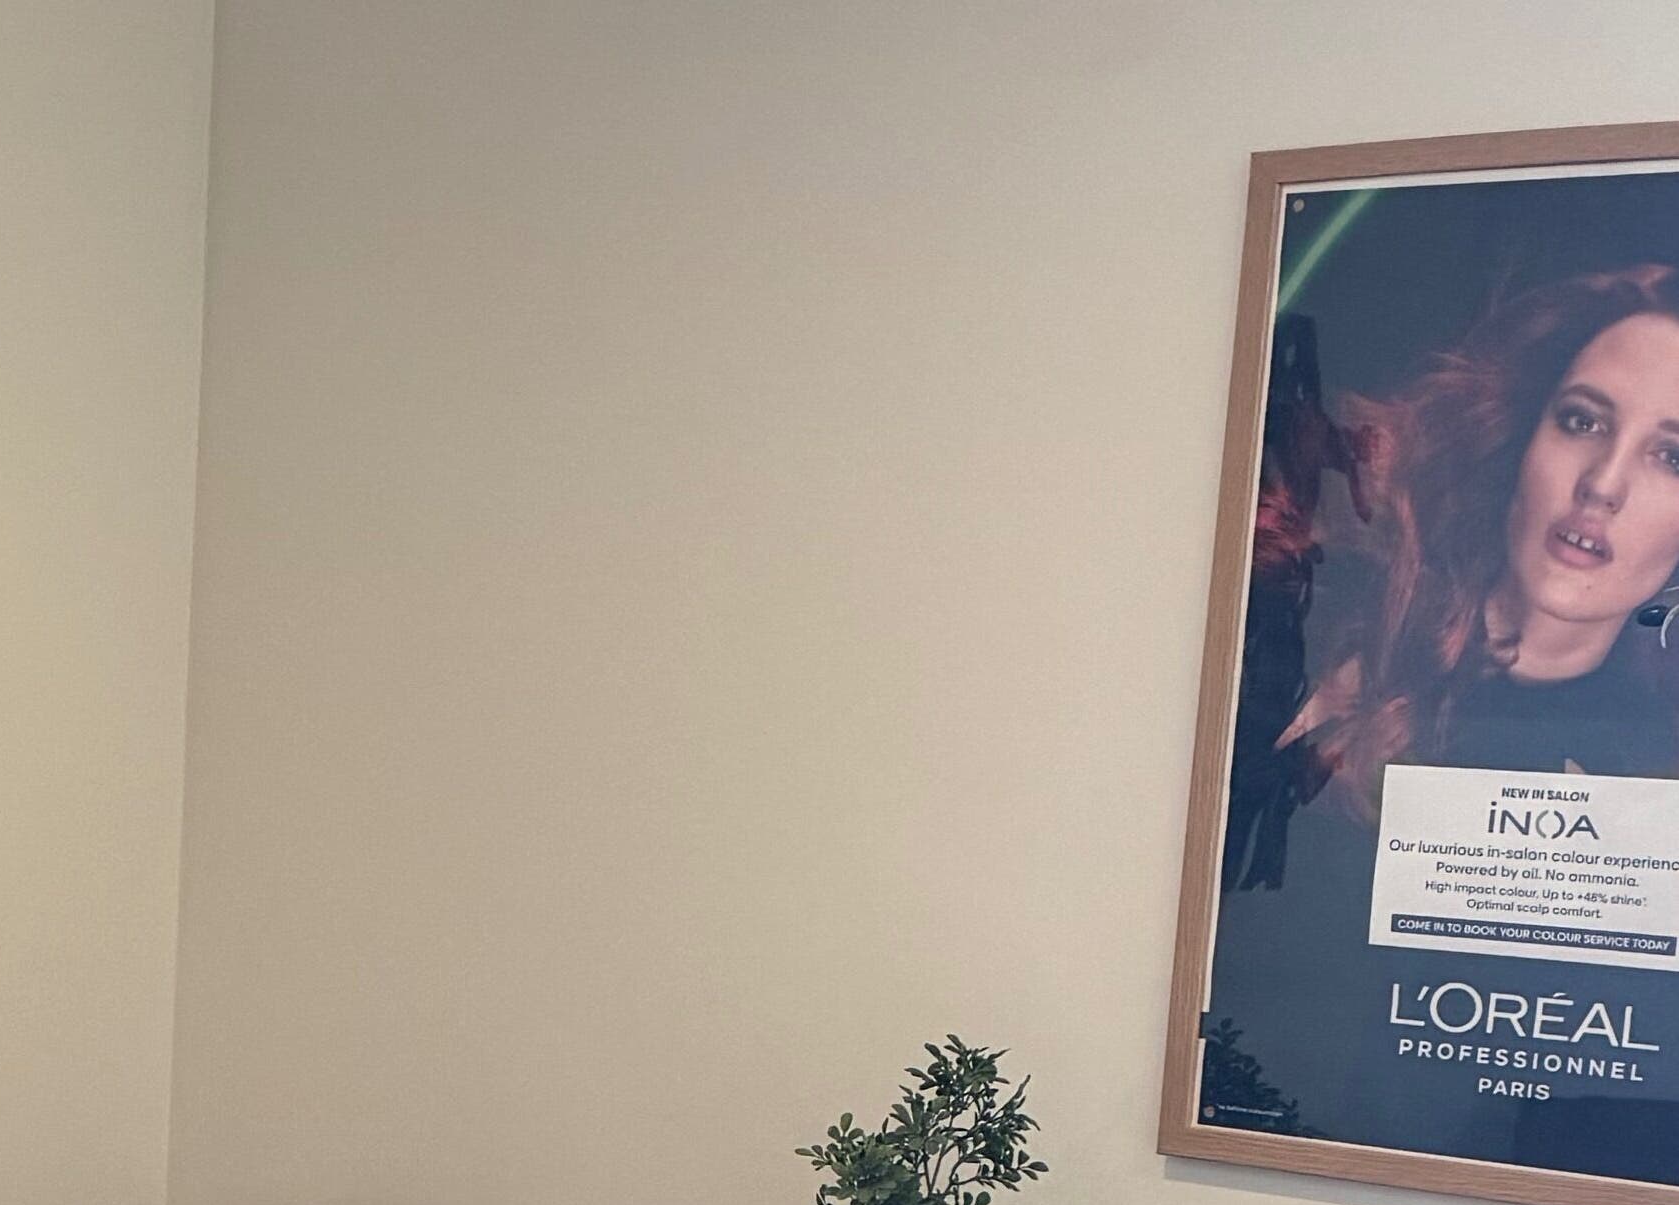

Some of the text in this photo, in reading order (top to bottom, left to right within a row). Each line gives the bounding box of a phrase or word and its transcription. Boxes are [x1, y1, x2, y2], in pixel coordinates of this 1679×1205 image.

[1502, 788, 1590, 802] NEW IN SALON
[1389, 839, 1679, 871] Our luxurious in-salon colour experienc
[1436, 862, 1639, 887] Powered by oil. No ammonia.
[1425, 881, 1451, 893] High
[1454, 882, 1496, 896] impact
[1542, 889, 1559, 901] Up
[1562, 890, 1574, 900] to
[1466, 899, 1603, 918] Optimal scalp comfort.
[1397, 919, 1671, 951] COME IN TO BOOK YOUR COLOUR SERVICE TODAY
[1390, 982, 1660, 1051] L'ORÉAL
[1398, 1039, 1644, 1081] PROFESSIONNEL
[1478, 1078, 1551, 1100] PARIS
